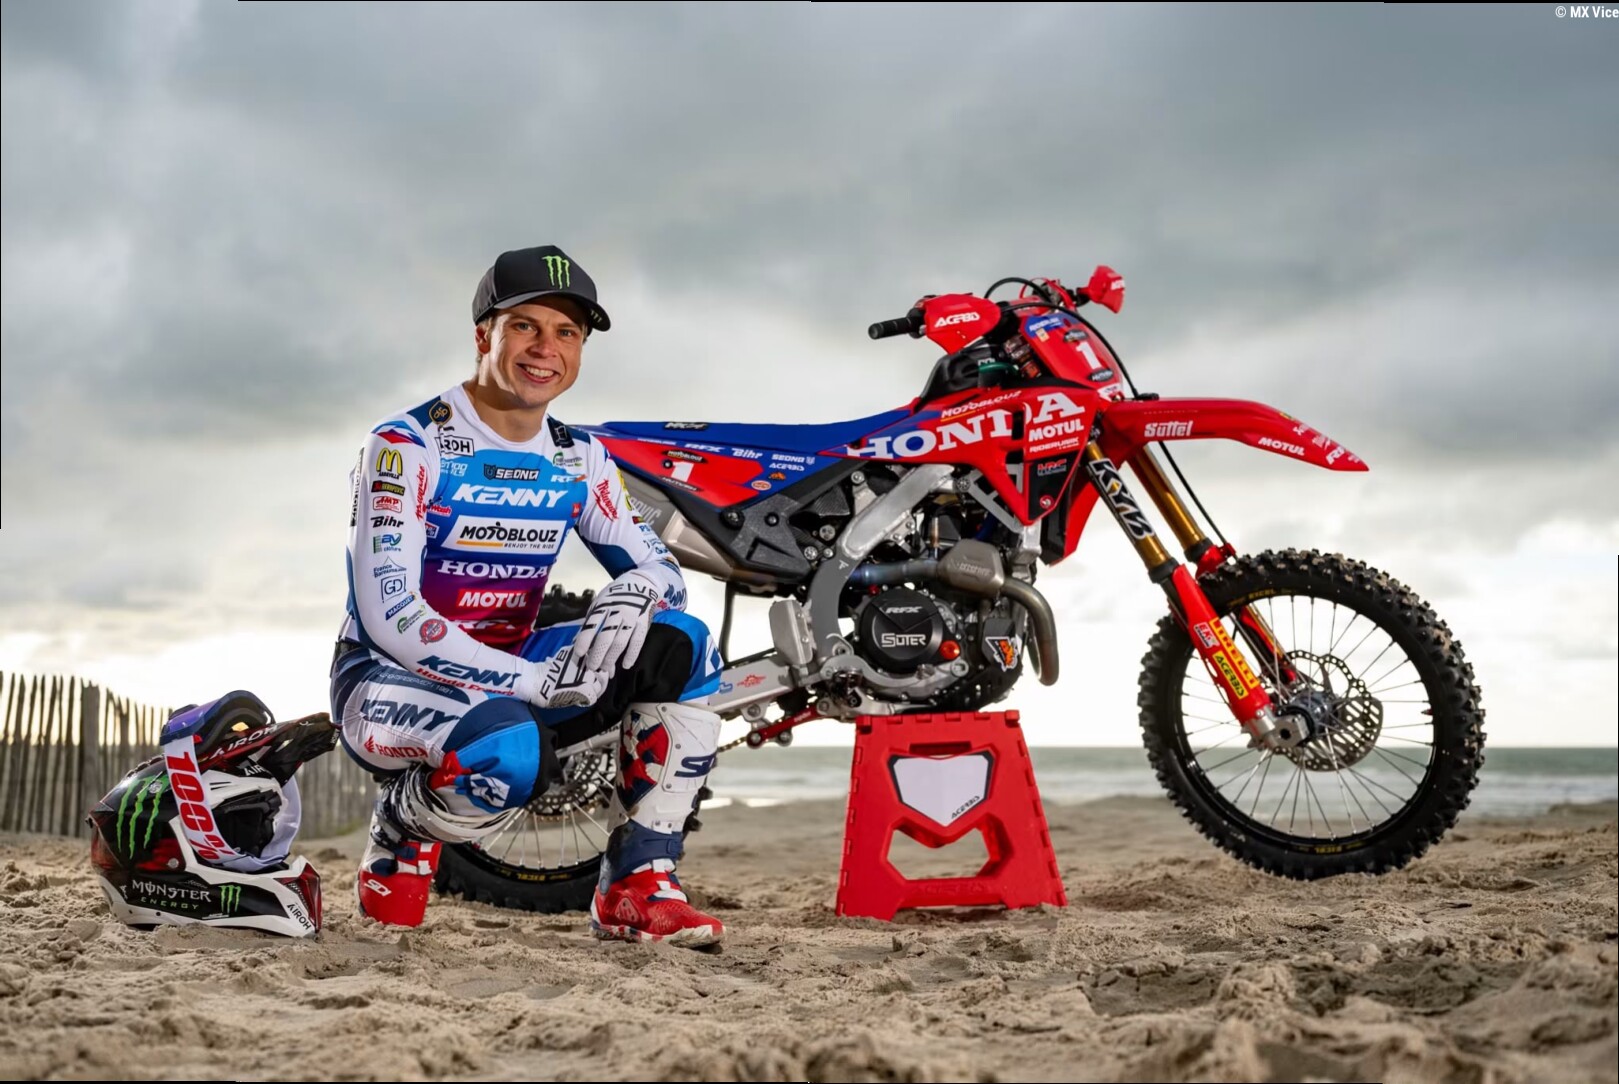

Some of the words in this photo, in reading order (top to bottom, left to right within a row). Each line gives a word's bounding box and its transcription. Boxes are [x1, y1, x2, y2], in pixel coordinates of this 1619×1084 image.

[1076, 341, 1102, 370] 1
[940, 390, 1021, 419] MOTOBLOUZ
[847, 392, 1085, 459] HONDA
[1029, 419, 1084, 442] MOTUL
[731, 447, 763, 459] Bihr
[1258, 437, 1305, 456] MOTUL
[672, 461, 695, 483] 1
[452, 483, 569, 508] KENNY
[370, 515, 404, 528] Bihr
[460, 523, 558, 542] MOTOBLOUZ
[437, 560, 548, 579] HONDA
[458, 591, 527, 608] MOTUL
[609, 583, 659, 602] FIVE
[885, 606, 922, 614] RFX
[881, 632, 926, 648] SUTER
[416, 667, 466, 689] Honda
[540, 649, 568, 699] FIVE
[360, 698, 460, 731] KENNY
[209, 724, 278, 760] AIROH
[244, 763, 266, 777] AIR
[166, 751, 236, 862] 100%
[131, 879, 212, 903] MONSTER
[140, 896, 199, 910] ENERGY
[286, 902, 312, 931] AIROH
